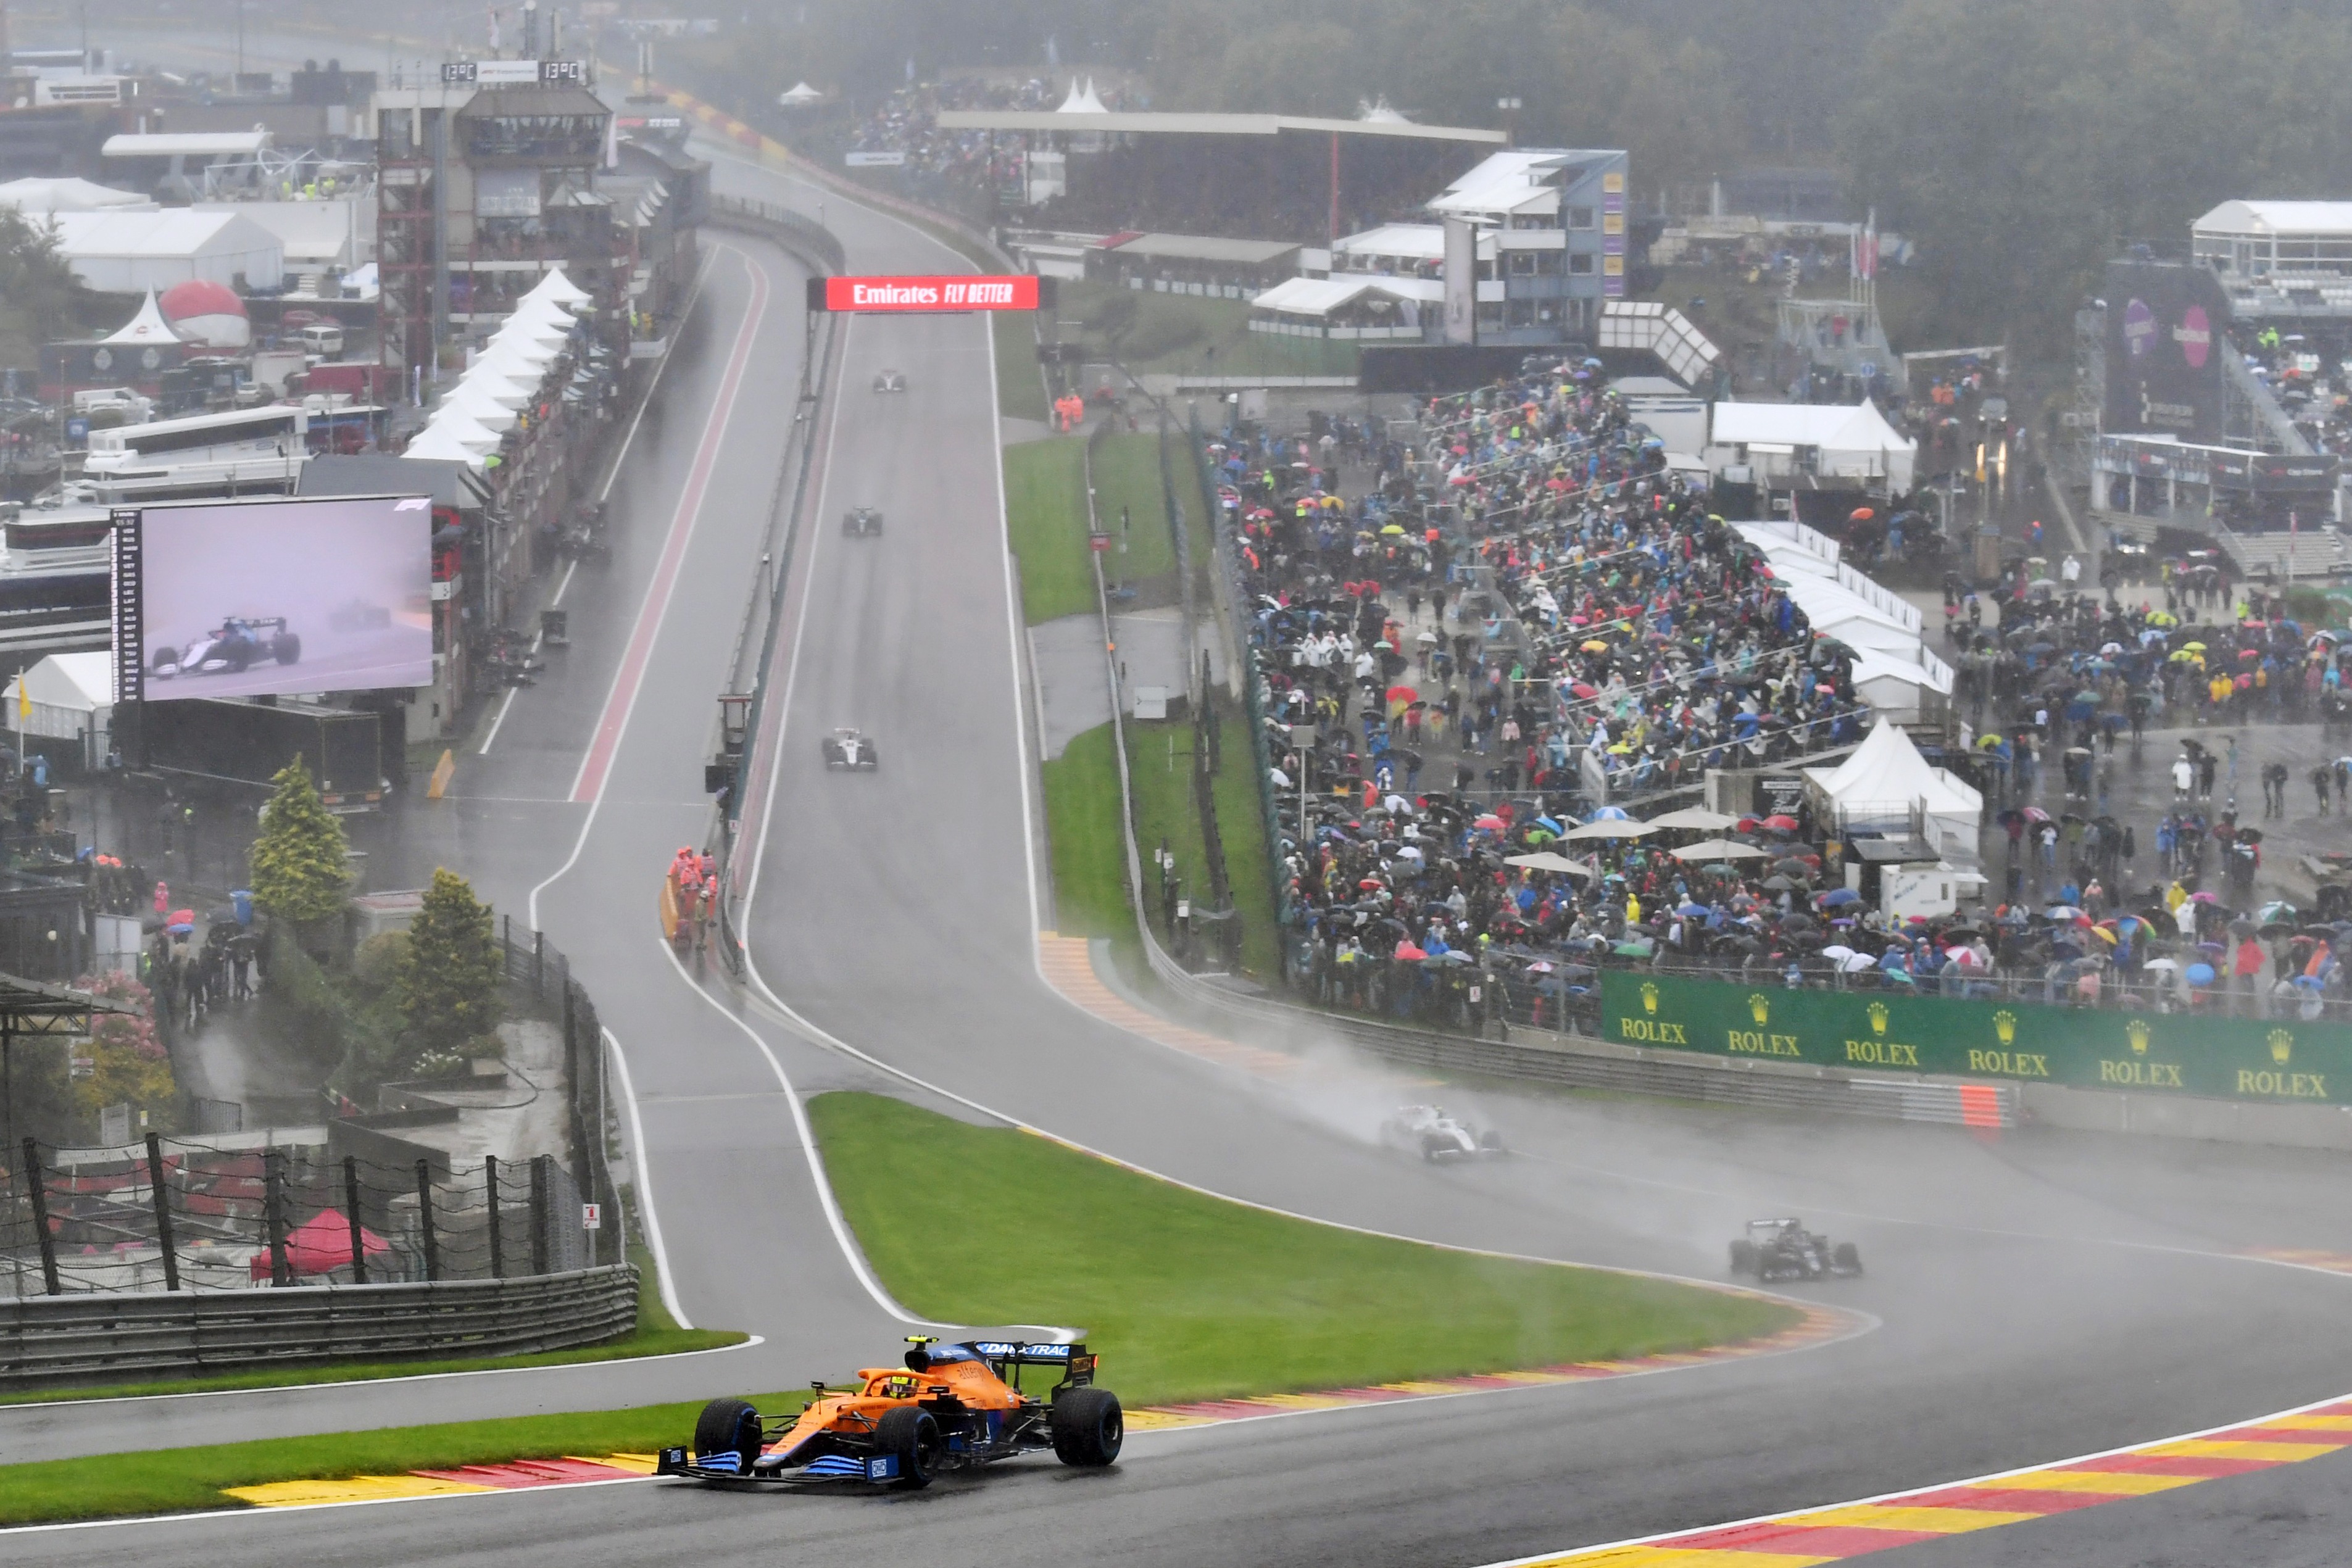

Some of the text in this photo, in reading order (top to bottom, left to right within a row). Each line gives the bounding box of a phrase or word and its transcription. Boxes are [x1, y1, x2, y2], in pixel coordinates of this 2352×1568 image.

[854, 284, 1013, 304] Emirates FLY BETTER
[1621, 1018, 1687, 1044] ROLEX
[1728, 1030, 1800, 1056] ROLEX
[1846, 1040, 1919, 1066] ROLEX
[1969, 1050, 2049, 1077] ROLEX
[2100, 1060, 2184, 1087] ROLEX
[2237, 1069, 2327, 1098] ROLEX
